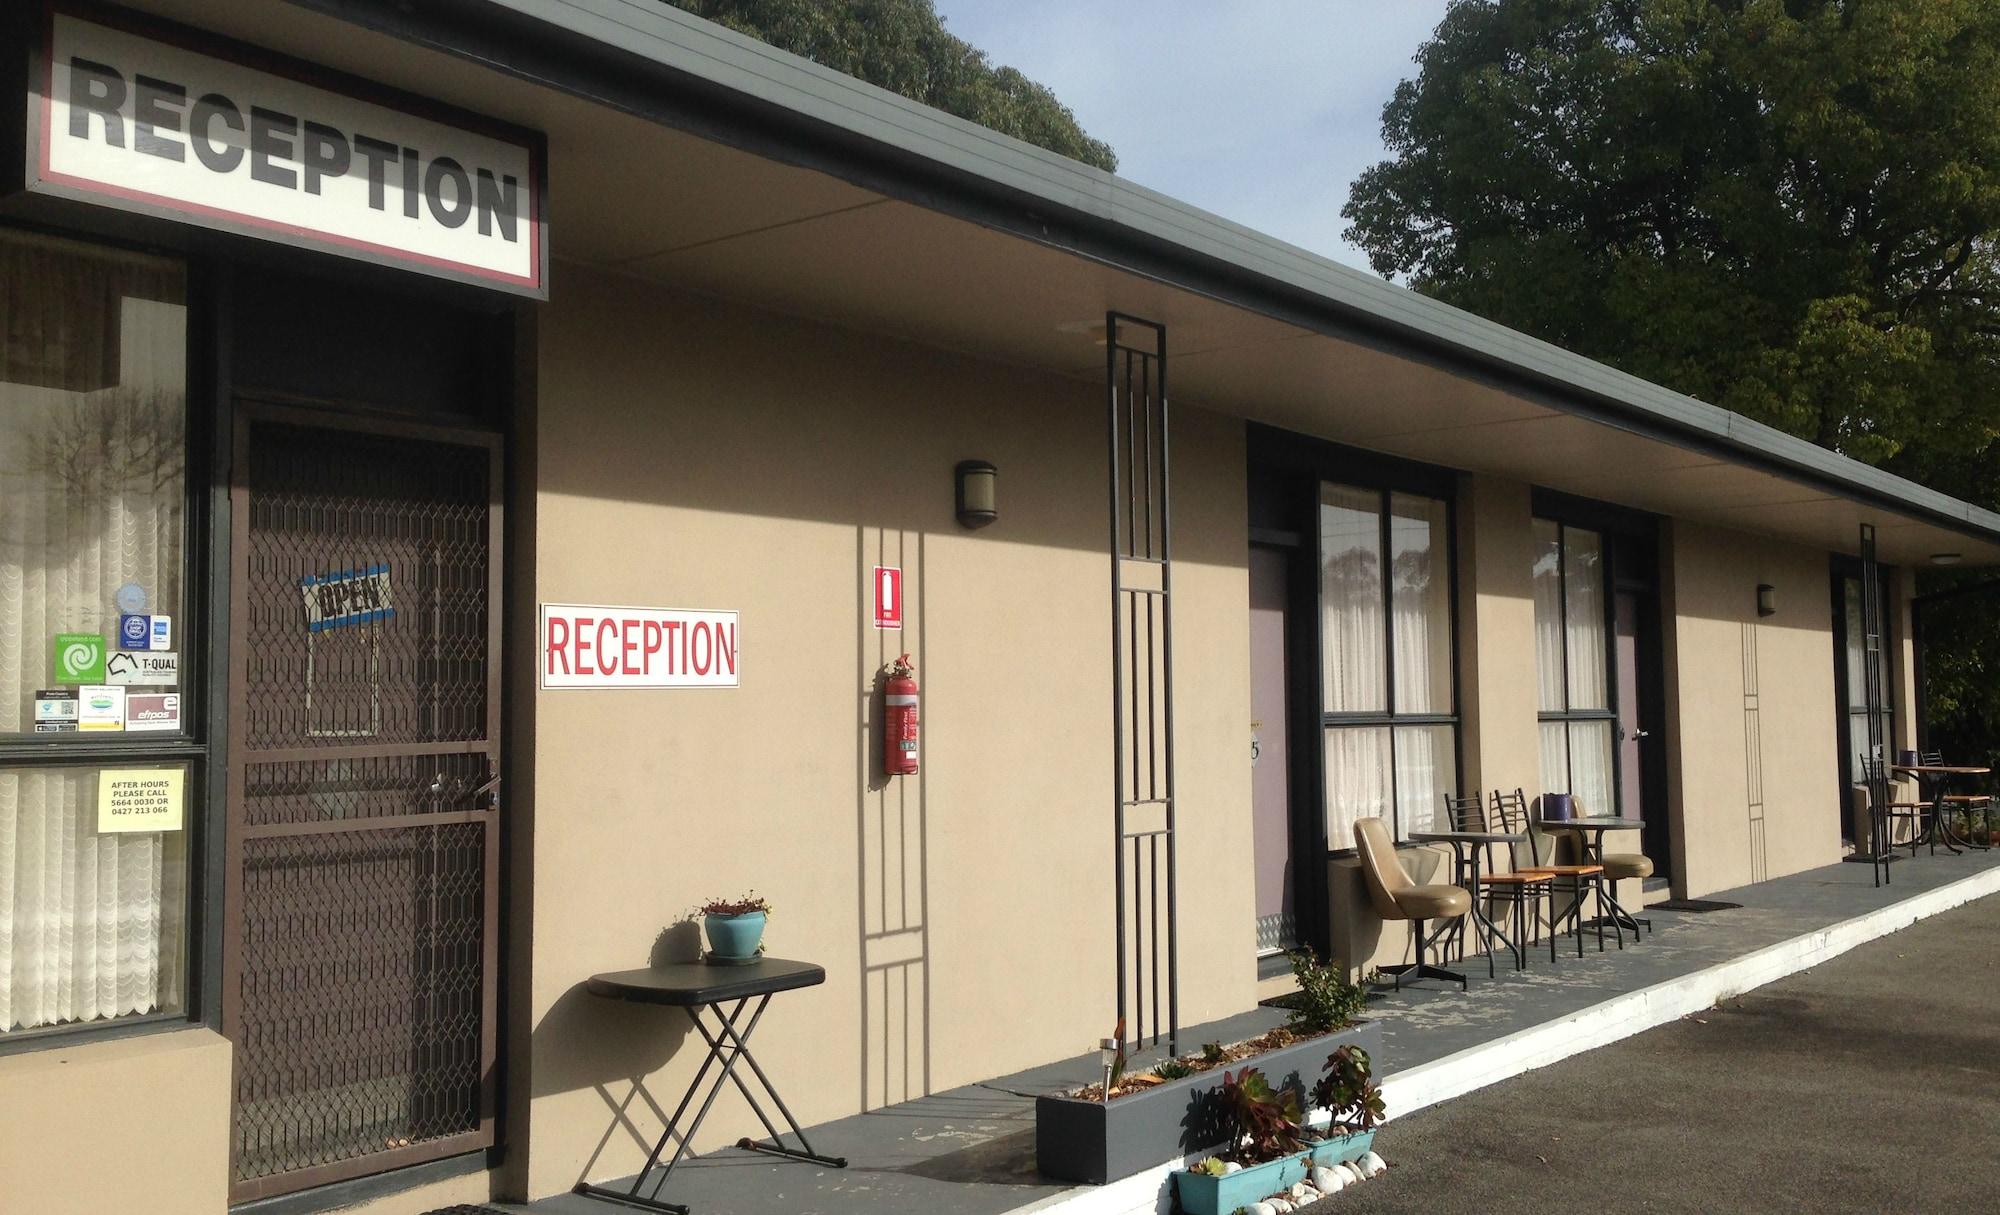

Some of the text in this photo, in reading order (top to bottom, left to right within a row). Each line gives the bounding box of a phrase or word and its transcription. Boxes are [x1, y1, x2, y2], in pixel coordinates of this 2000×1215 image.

[69, 56, 517, 243] RECEPTION
[319, 577, 381, 618] OPEN
[548, 617, 735, 676] RECEPTION
[137, 709, 170, 720] eftpos
[140, 780, 169, 788] HOURS
[134, 798, 154, 806] 0030
